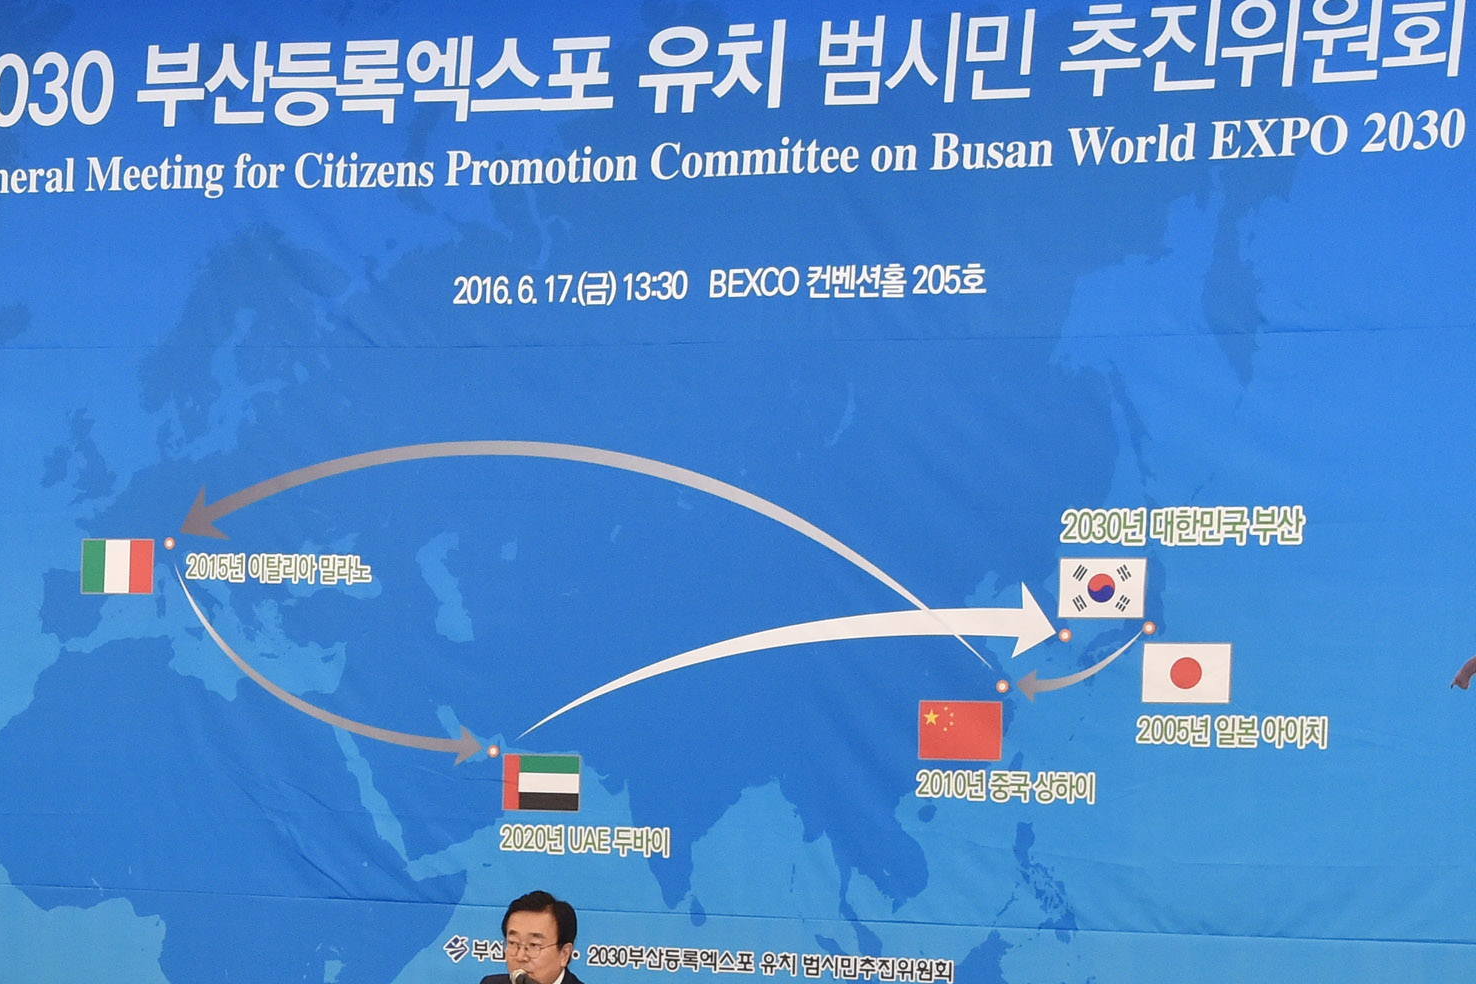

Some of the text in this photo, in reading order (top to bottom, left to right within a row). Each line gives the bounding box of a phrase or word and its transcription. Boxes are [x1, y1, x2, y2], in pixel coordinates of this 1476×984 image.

[137, 35, 614, 127] 부산등록엑스포
[638, 18, 787, 114] 유치
[819, 8, 1035, 106] 범시민
[1060, 0, 1466, 97] 추진위원회
[85, 154, 225, 199] Meeting
[234, 152, 285, 189] for
[294, 152, 434, 189] Citizens
[444, 145, 637, 187] Promotion
[650, 136, 859, 180] Committee
[871, 144, 917, 173] on
[929, 132, 1053, 170] Busan
[1067, 122, 1196, 166] World
[1209, 114, 1348, 160] EXPO
[1361, 108, 1466, 153] 2030
[623, 270, 688, 301] 13:30
[709, 267, 800, 299] BEXCO
[806, 264, 907, 299] 컨벤션홀
[912, 263, 987, 296] 205호
[1060, 505, 1307, 546] 2030년 대한민국 부산
[186, 553, 373, 586] 2015년 이탈리아 밀라노
[1136, 715, 1329, 750] 2005년 일본 아이치
[915, 769, 1097, 804] 2010년 중국 상하이
[499, 824, 671, 859] 2020년 UAE 두바이
[587, 945, 955, 984] 2030부산등록엑스포 유치 범시민추진위원회
